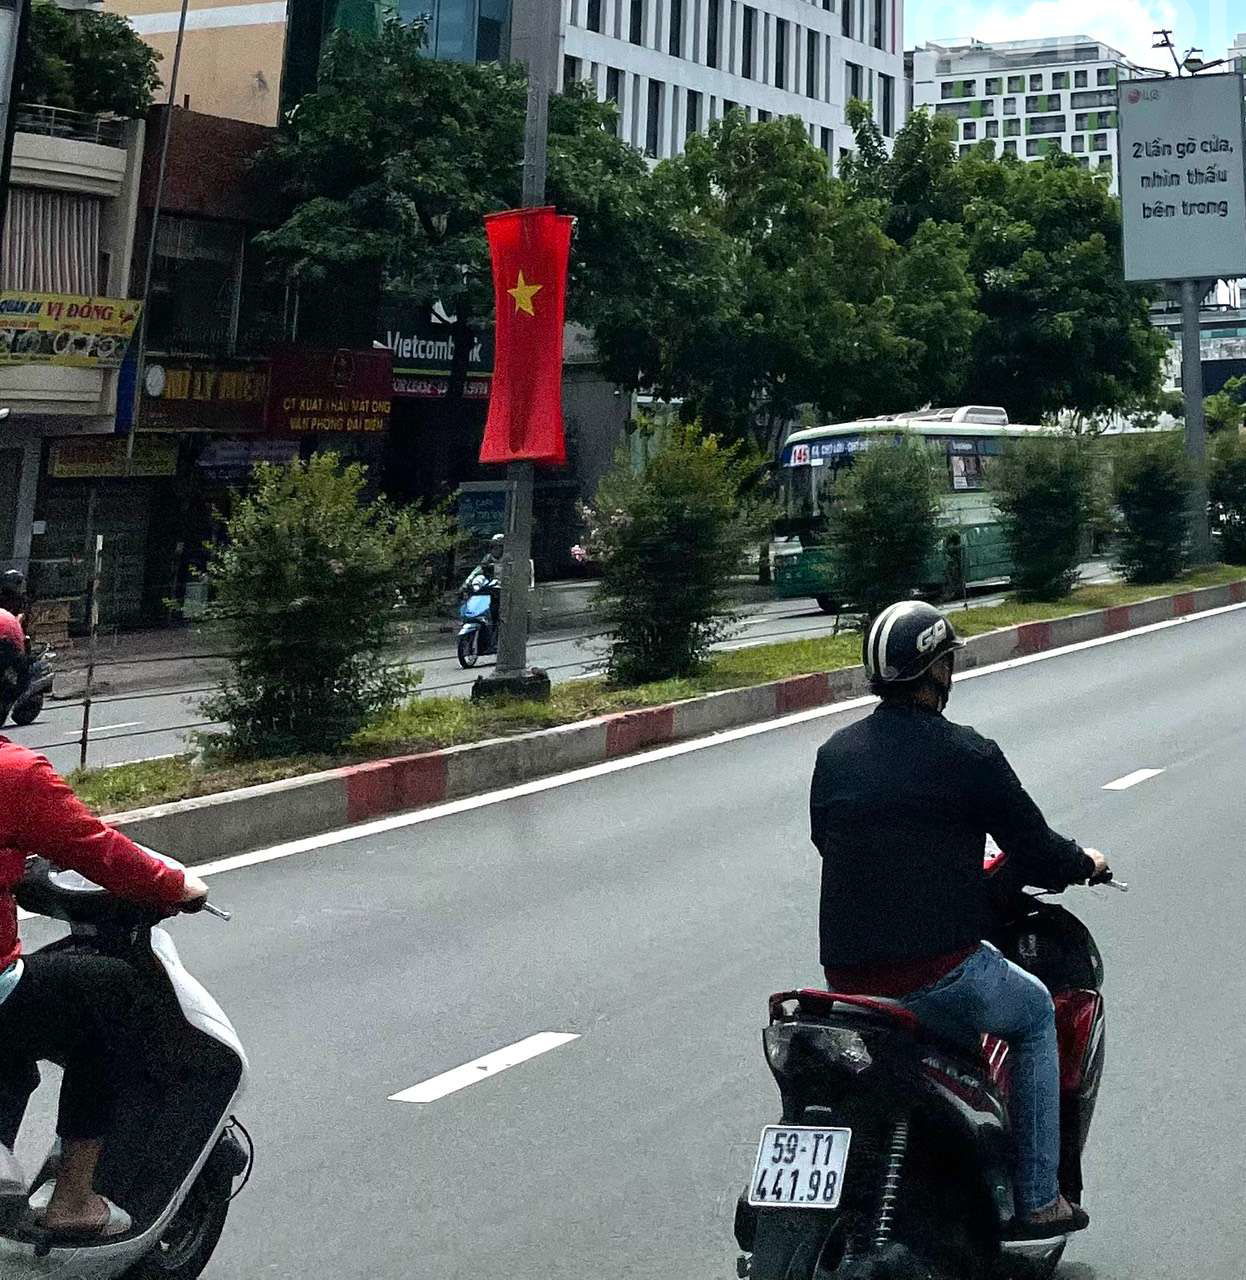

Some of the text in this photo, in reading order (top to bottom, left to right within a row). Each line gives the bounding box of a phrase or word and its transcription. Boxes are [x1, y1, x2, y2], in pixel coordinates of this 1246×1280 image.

[1132, 142, 1142, 158] 2
[1142, 200, 1229, 219] bên trong
[387, 330, 482, 362] Vietcombk
[771, 1132, 834, 1166] 59-T1
[756, 1168, 838, 1202] 441.98
